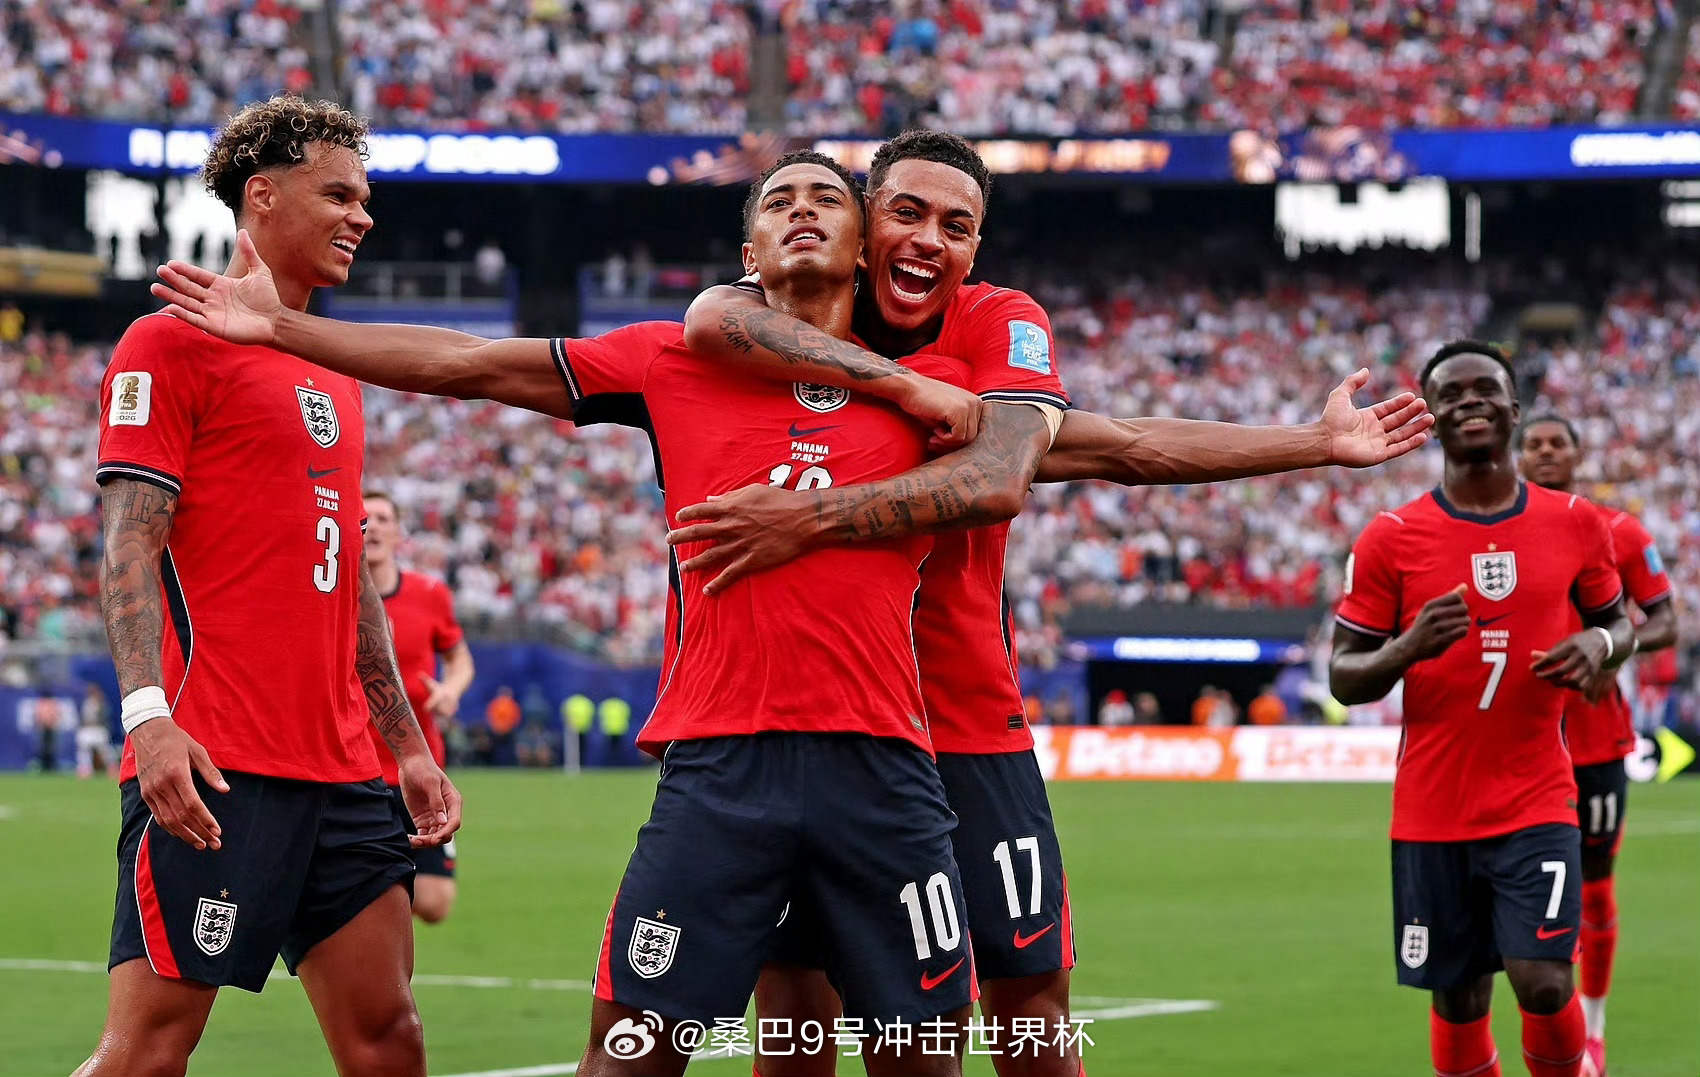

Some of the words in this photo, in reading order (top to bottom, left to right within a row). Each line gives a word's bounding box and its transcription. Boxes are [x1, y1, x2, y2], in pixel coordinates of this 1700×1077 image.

[790, 441, 829, 455] PANAMA
[314, 485, 340, 501] PANAMA
[313, 515, 341, 593] 3
[1479, 651, 1508, 710] 7
[1067, 730, 1223, 776] Betano
[1588, 792, 1617, 834] 11
[993, 836, 1041, 919] 17
[1541, 860, 1567, 919] 7
[900, 872, 960, 961] 10
